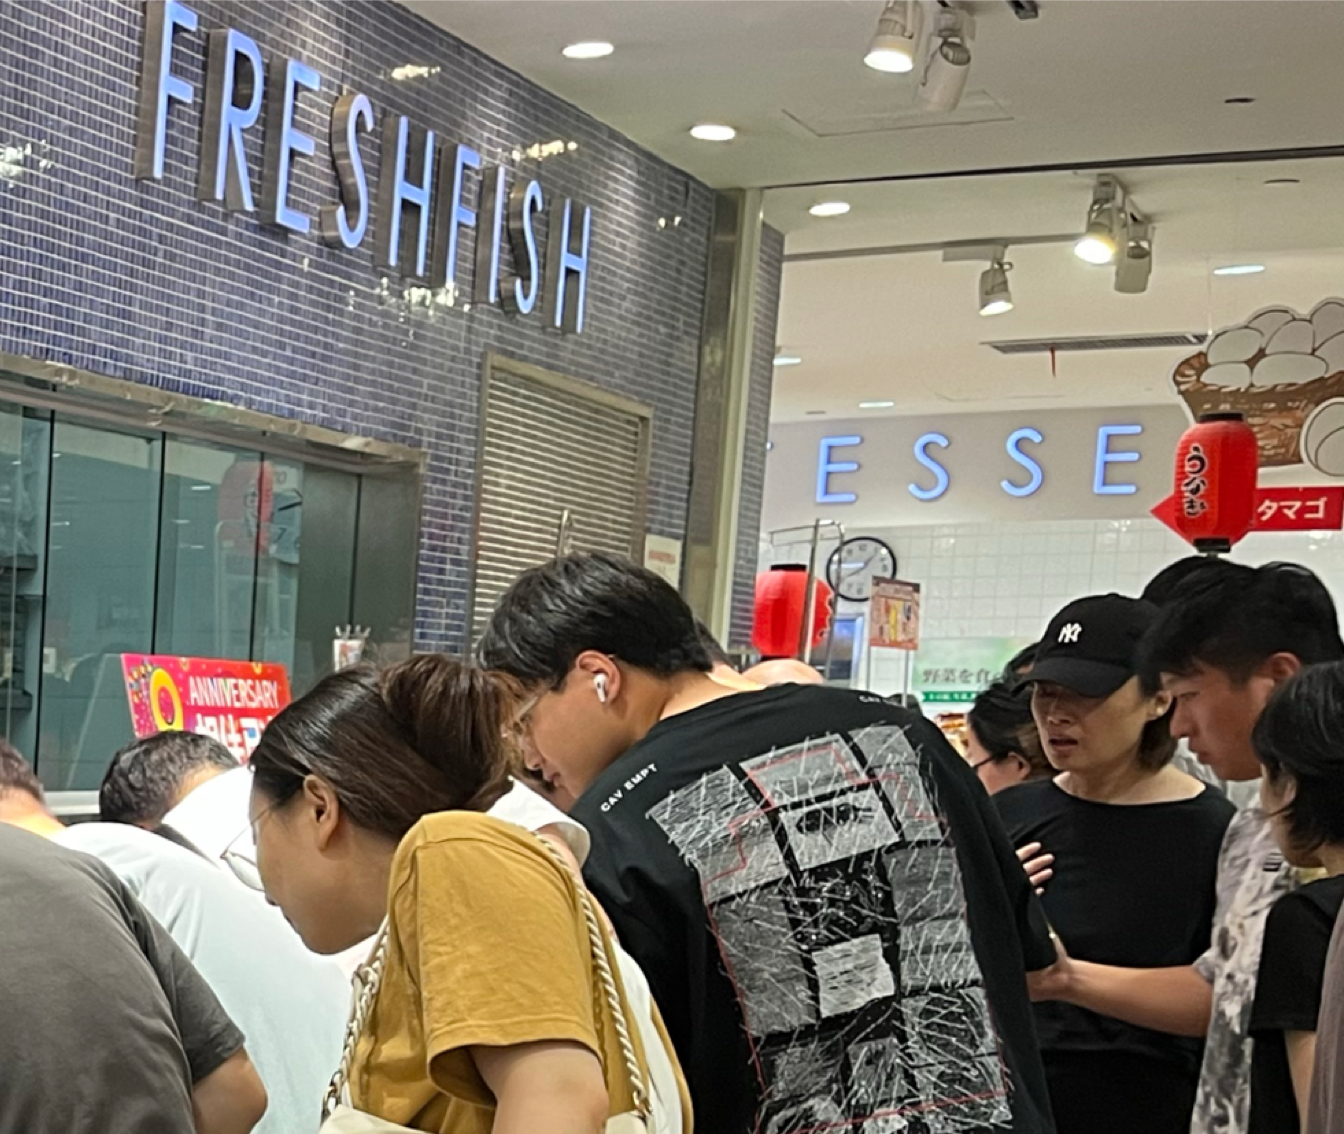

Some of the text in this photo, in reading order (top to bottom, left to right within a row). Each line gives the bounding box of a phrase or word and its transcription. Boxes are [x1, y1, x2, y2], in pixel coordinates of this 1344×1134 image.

[150, 0, 591, 334] FRESHFISH
[813, 424, 1144, 504] ESSE
[1181, 443, 1208, 518] うなぎ
[1257, 497, 1328, 521] タマゴ
[188, 675, 280, 709] ANNIVERSARY
[600, 763, 657, 812] CAV EMPT
